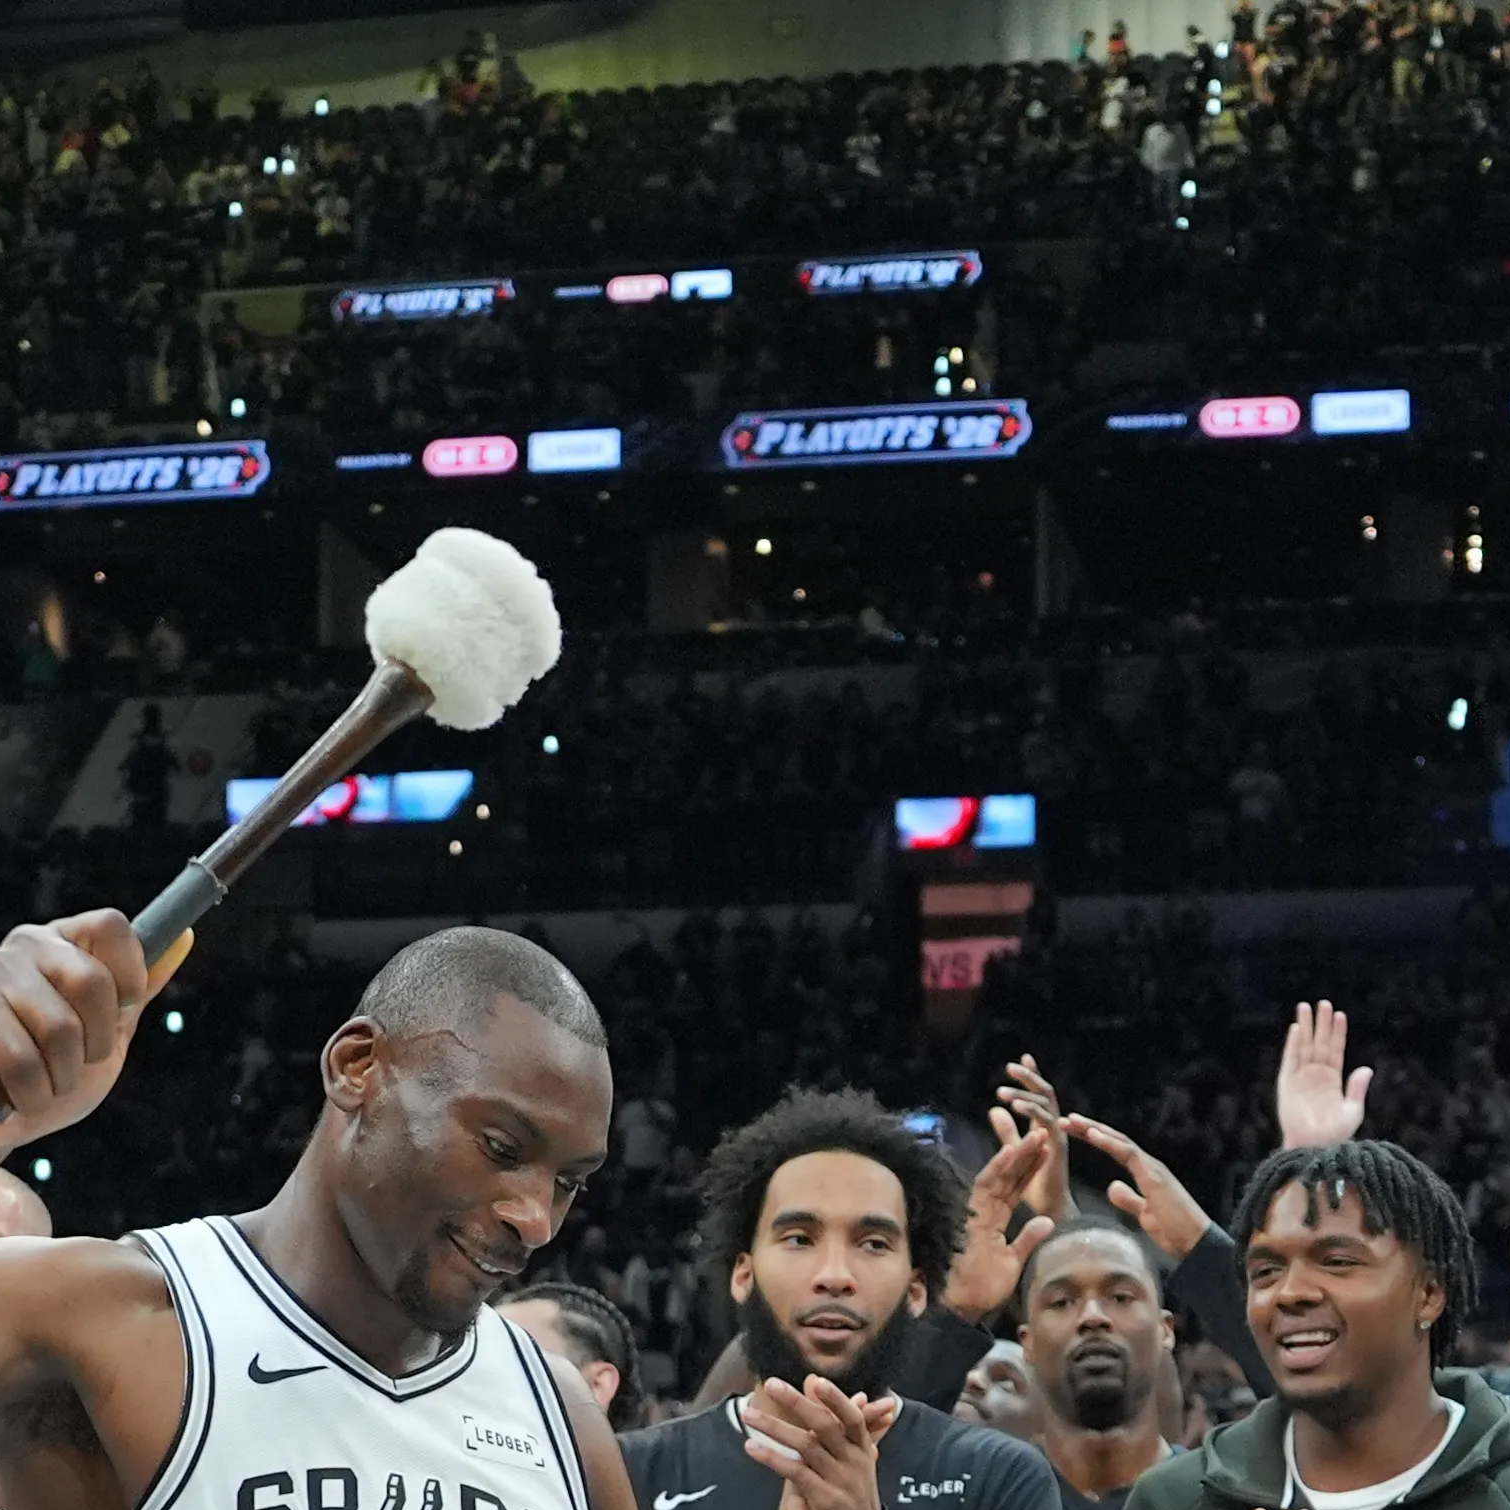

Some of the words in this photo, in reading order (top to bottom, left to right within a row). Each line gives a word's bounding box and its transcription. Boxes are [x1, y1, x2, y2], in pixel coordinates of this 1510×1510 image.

[751, 415, 939, 456] PLAYOFFS
[10, 457, 183, 497] PLAYOFFS
[475, 1427, 533, 1455] LEDGER
